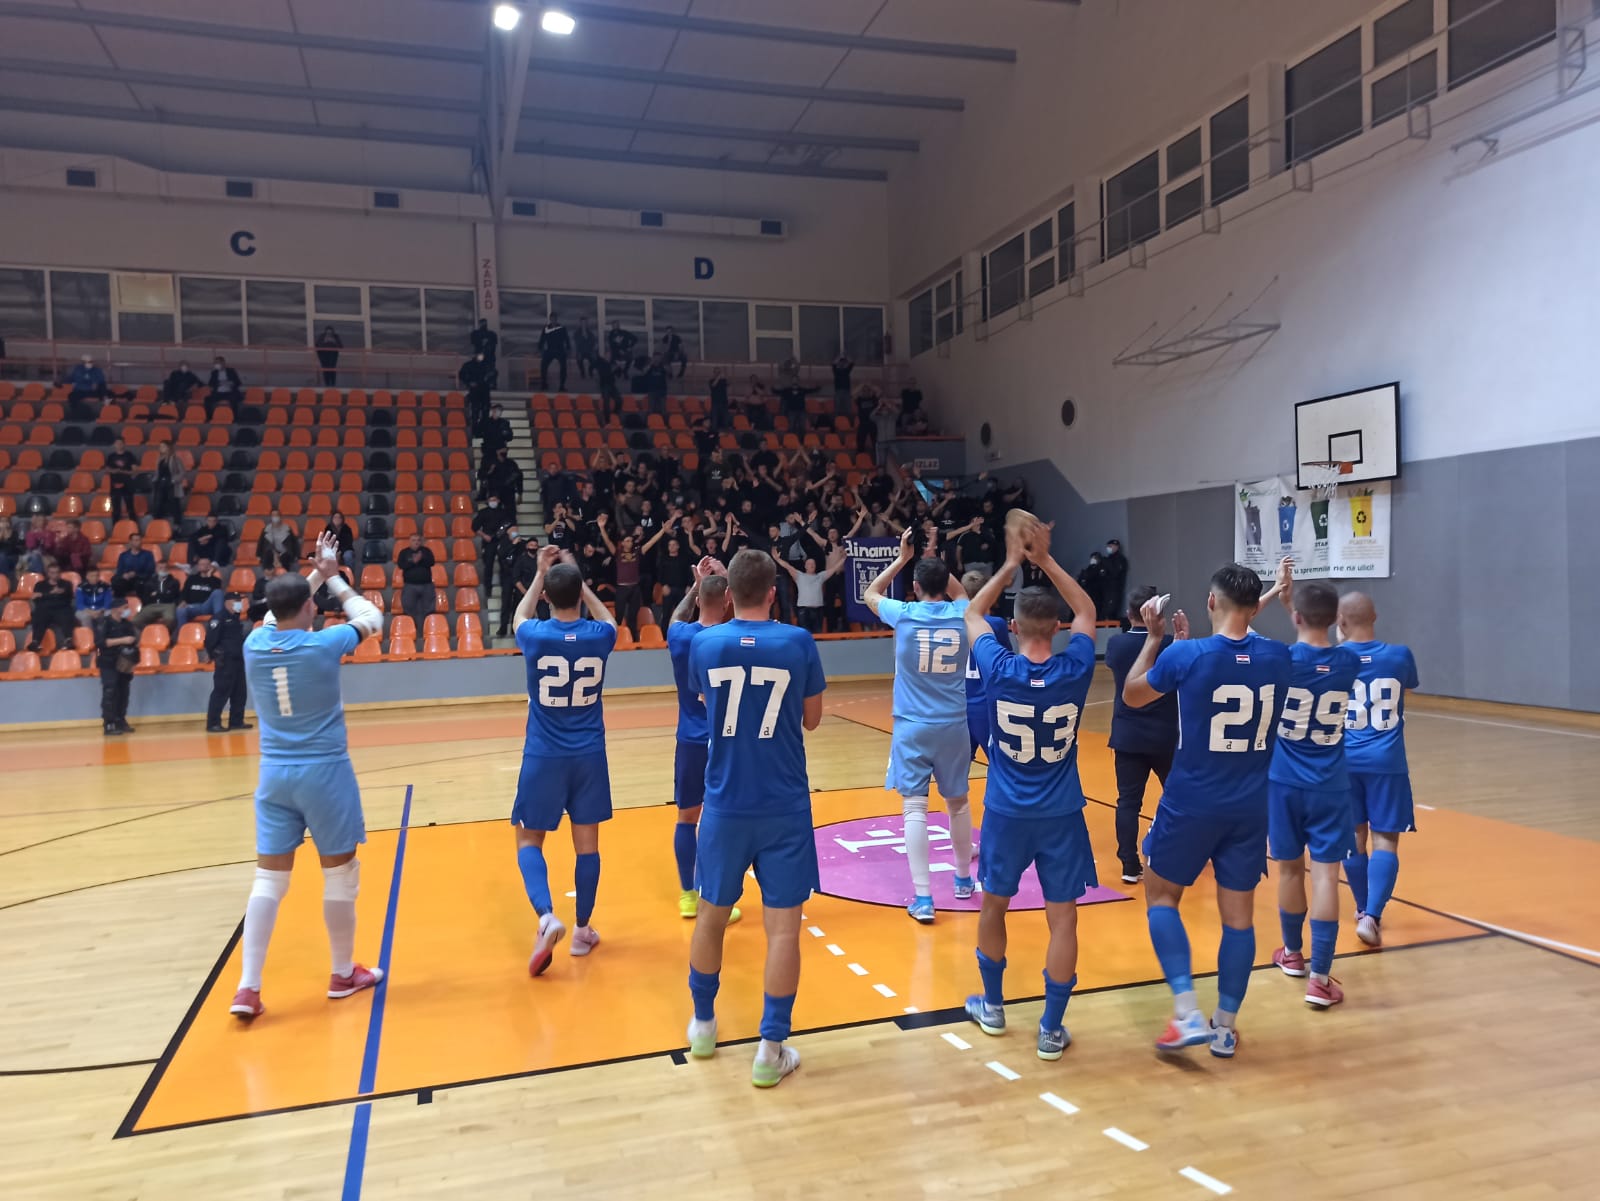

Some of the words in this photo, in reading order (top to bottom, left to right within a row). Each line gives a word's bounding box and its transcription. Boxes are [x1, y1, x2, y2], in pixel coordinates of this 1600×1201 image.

[230, 231, 256, 256] C
[694, 257, 714, 280] D
[482, 259, 493, 310] ZAPAD
[845, 540, 902, 557] dinamo
[916, 629, 960, 673] 12
[272, 667, 293, 717] 1
[537, 656, 603, 707] 22
[708, 666, 791, 739] 77
[997, 700, 1078, 764] 53
[1209, 684, 1276, 752] 21
[1277, 687, 1349, 746] 99
